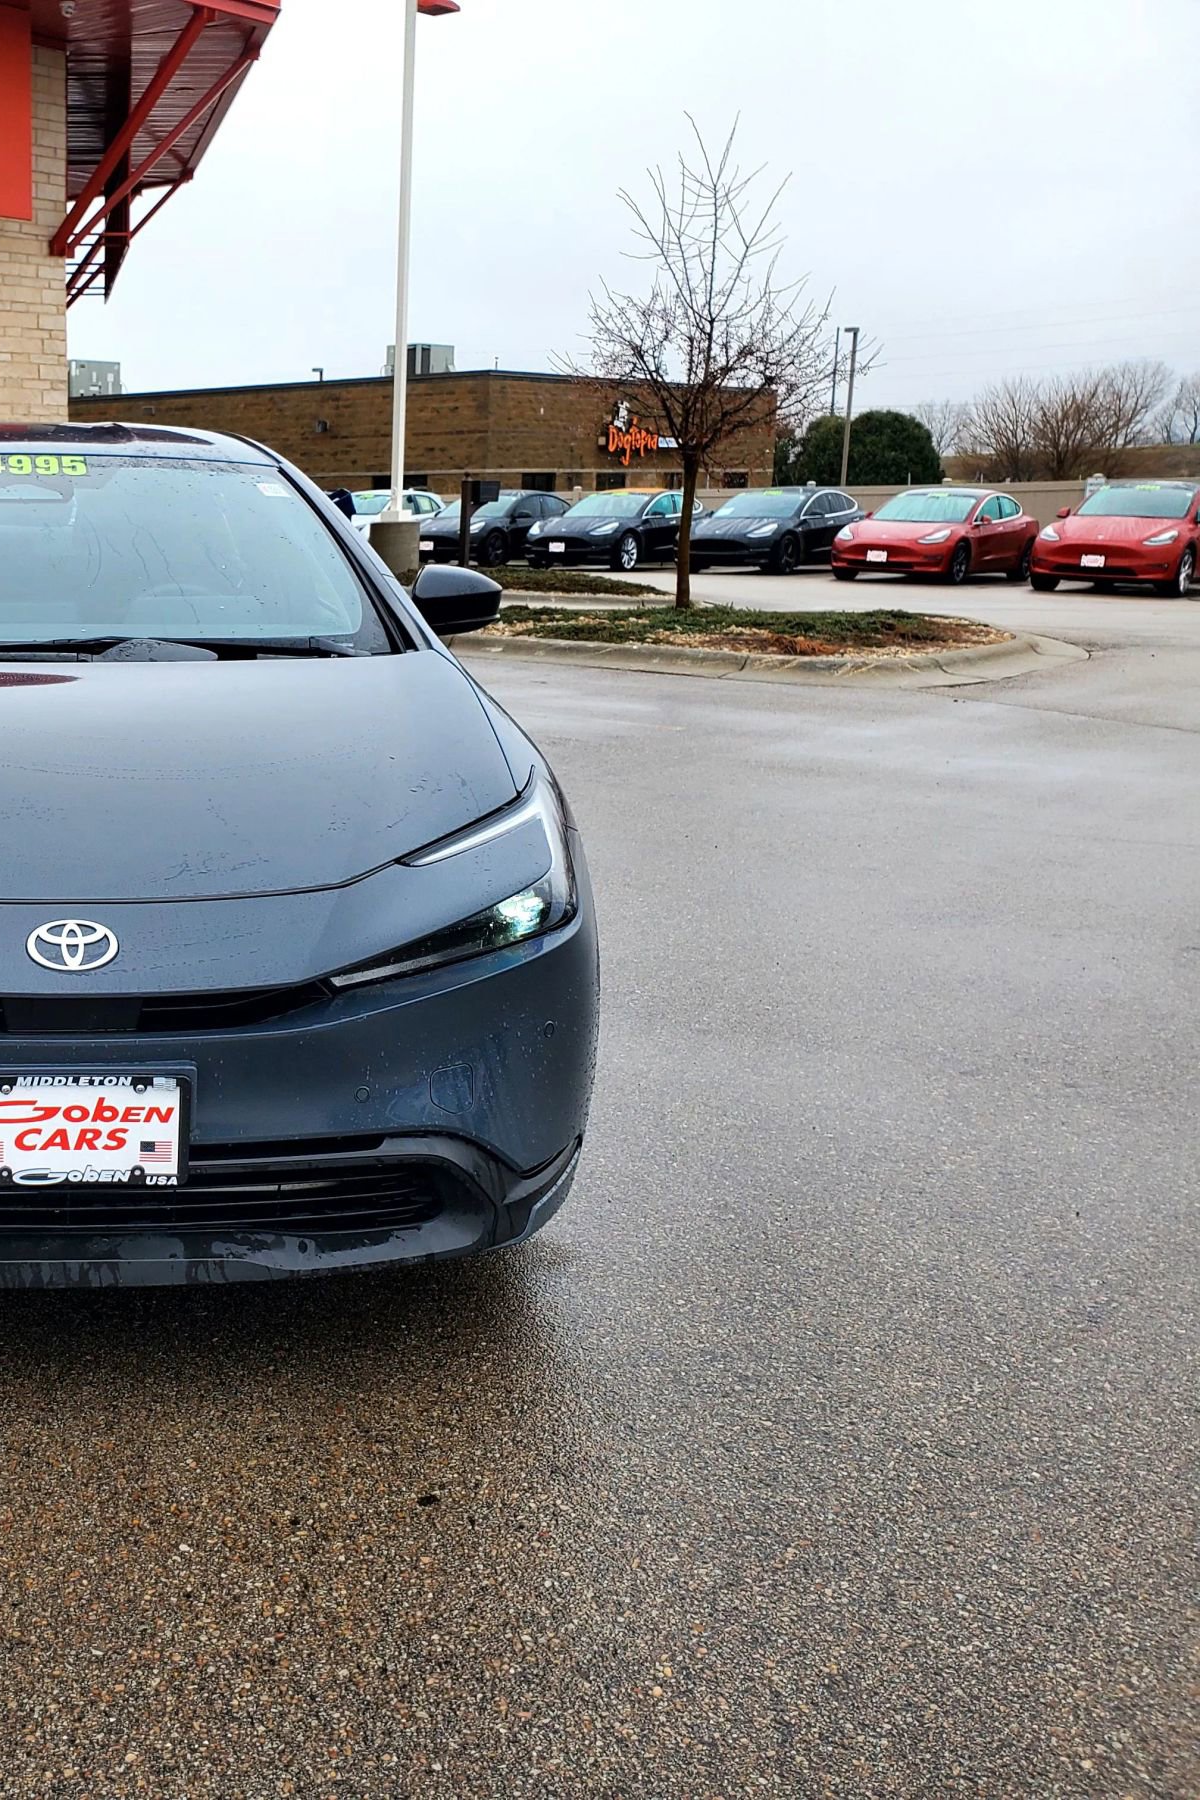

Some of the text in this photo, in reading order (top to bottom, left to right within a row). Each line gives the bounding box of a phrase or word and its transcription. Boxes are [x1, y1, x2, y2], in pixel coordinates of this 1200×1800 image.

[16, 1076, 133, 1087] MIDDLETON
[14, 1128, 130, 1151] CARS
[145, 1175, 178, 1186] USA
